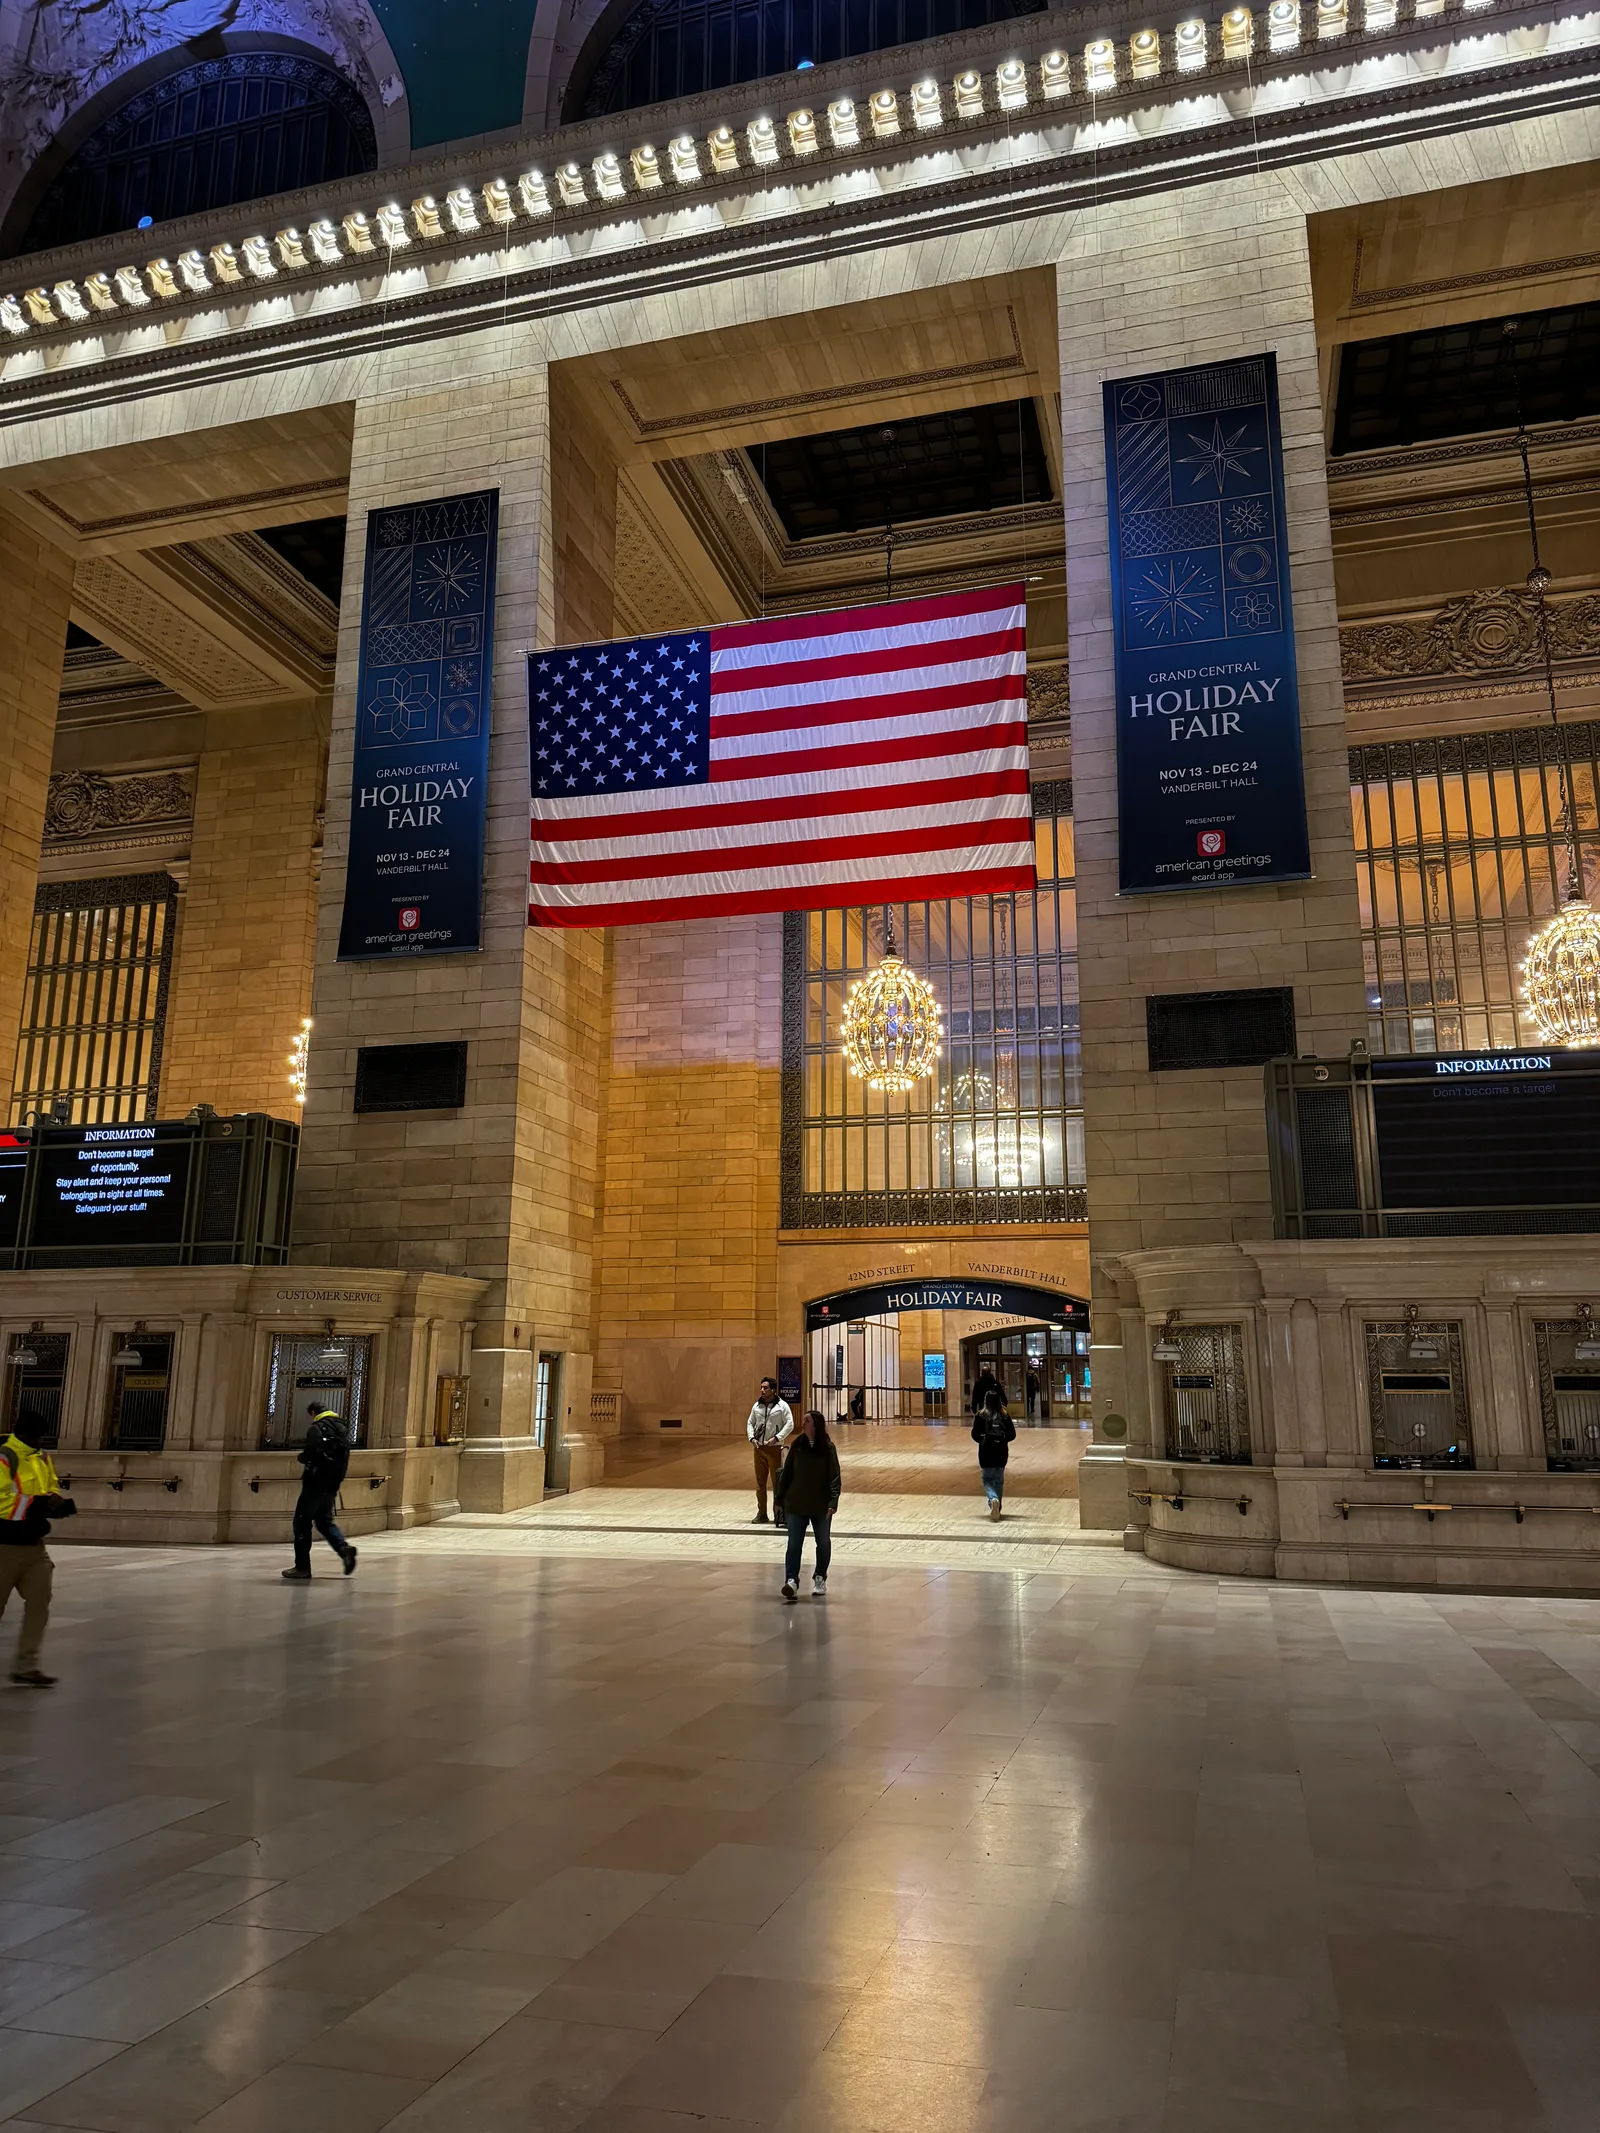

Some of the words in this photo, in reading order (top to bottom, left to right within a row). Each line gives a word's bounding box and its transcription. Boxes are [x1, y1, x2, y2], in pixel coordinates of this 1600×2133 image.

[1148, 669, 1197, 684] GRAND
[1199, 661, 1260, 677] CENTRAL
[1129, 677, 1282, 718] HOLIDAY
[1169, 712, 1244, 741] FAIR
[376, 767, 413, 779] GRAND
[414, 761, 460, 775] CENTRAL
[1159, 768, 1186, 780] NOV
[1189, 767, 1202, 777] 13
[1213, 763, 1240, 774] DEC
[1242, 761, 1258, 771] 24
[359, 776, 475, 808] HOLIDAY
[1161, 779, 1228, 794] VANDERBILT
[1230, 777, 1258, 788] HALL
[387, 805, 443, 829] FAIR
[1185, 816, 1226, 825] PRESENTED
[376, 853, 397, 863] NOV
[399, 852, 409, 861] 13
[416, 849, 437, 859] DEC
[438, 848, 450, 858] 24
[376, 863, 427, 875] VANDERBILT
[428, 862, 449, 871] HALL
[1155, 860, 1210, 873] american
[1213, 854, 1272, 870] greetings
[1192, 871, 1216, 881] ecard
[1218, 872, 1235, 881] app
[391, 895, 422, 903] PRESENTED
[365, 933, 407, 944] american
[408, 929, 452, 943] greetings
[391, 944, 410, 952] ecard
[411, 944, 424, 952] app
[1436, 1056, 1551, 1074] INFORMATION
[1433, 1086, 1461, 1098] Don't
[1465, 1084, 1509, 1097] become
[1512, 1085, 1520, 1094] a
[1523, 1083, 1556, 1095] target
[84, 1128, 156, 1141] INFORMATION
[78, 1150, 97, 1160] Don't
[98, 1149, 125, 1159] become
[133, 1148, 154, 1159] target
[91, 1163, 99, 1172] of
[99, 1162, 139, 1173] opportunity.
[56, 1178, 72, 1188] Stay
[73, 1178, 89, 1186] alert
[90, 1177, 104, 1186] and
[104, 1176, 122, 1186] keep
[122, 1177, 139, 1186] your
[140, 1174, 171, 1185] personal
[60, 1190, 98, 1201] belongings
[99, 1190, 106, 1199] in
[107, 1190, 124, 1200] sight
[125, 1190, 133, 1198] at
[134, 1189, 143, 1197] all
[143, 1189, 165, 1197] times.
[75, 1204, 111, 1214] Safeguard
[112, 1204, 128, 1213] your
[129, 1202, 147, 1211] stuff!
[848, 1269, 875, 1282] 42ND
[877, 1264, 916, 1277] STREET
[968, 1262, 1038, 1280] VANDERBILT
[1039, 1272, 1068, 1287] HALL
[277, 1290, 341, 1301] CUSTOMER
[343, 1291, 383, 1303] SERVICE
[887, 1291, 963, 1309] HOLIDAY
[966, 1291, 1003, 1308] FAIR
[968, 1320, 992, 1332] 42ND
[994, 1315, 1027, 1327] STREET
